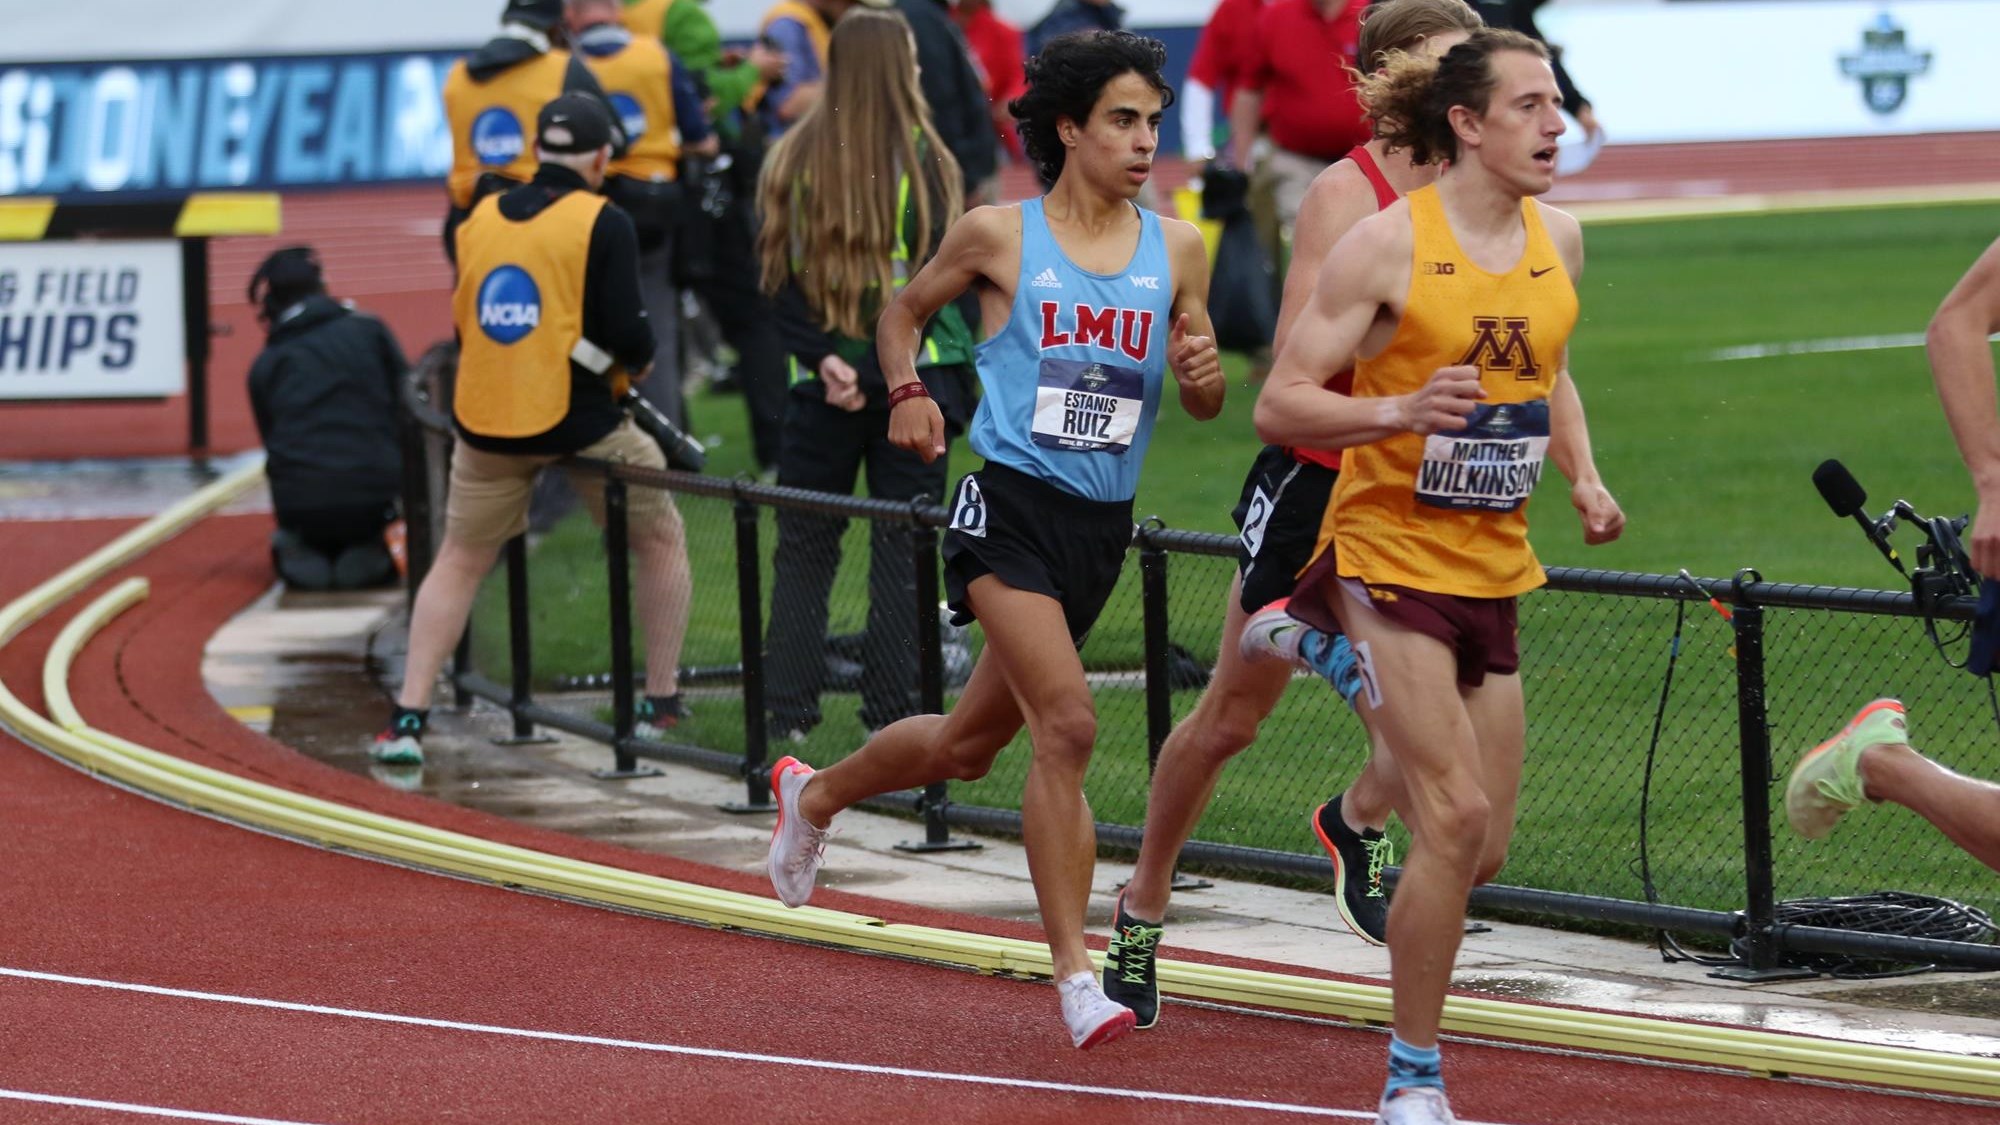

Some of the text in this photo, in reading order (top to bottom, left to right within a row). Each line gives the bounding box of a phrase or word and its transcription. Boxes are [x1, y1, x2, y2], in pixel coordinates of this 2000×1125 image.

[36, 269, 139, 304] FIELD
[1031, 279, 1063, 289] adidas
[479, 301, 539, 327] NCAA
[1040, 300, 1154, 364] LMU
[1451, 316, 1541, 380] M
[1064, 391, 1117, 413] ESTANIS
[1062, 409, 1112, 439] RUIZ
[1450, 441, 1530, 461] MATTHEW
[1421, 460, 1541, 497] WILKINSON
[1244, 496, 1265, 549] 2
